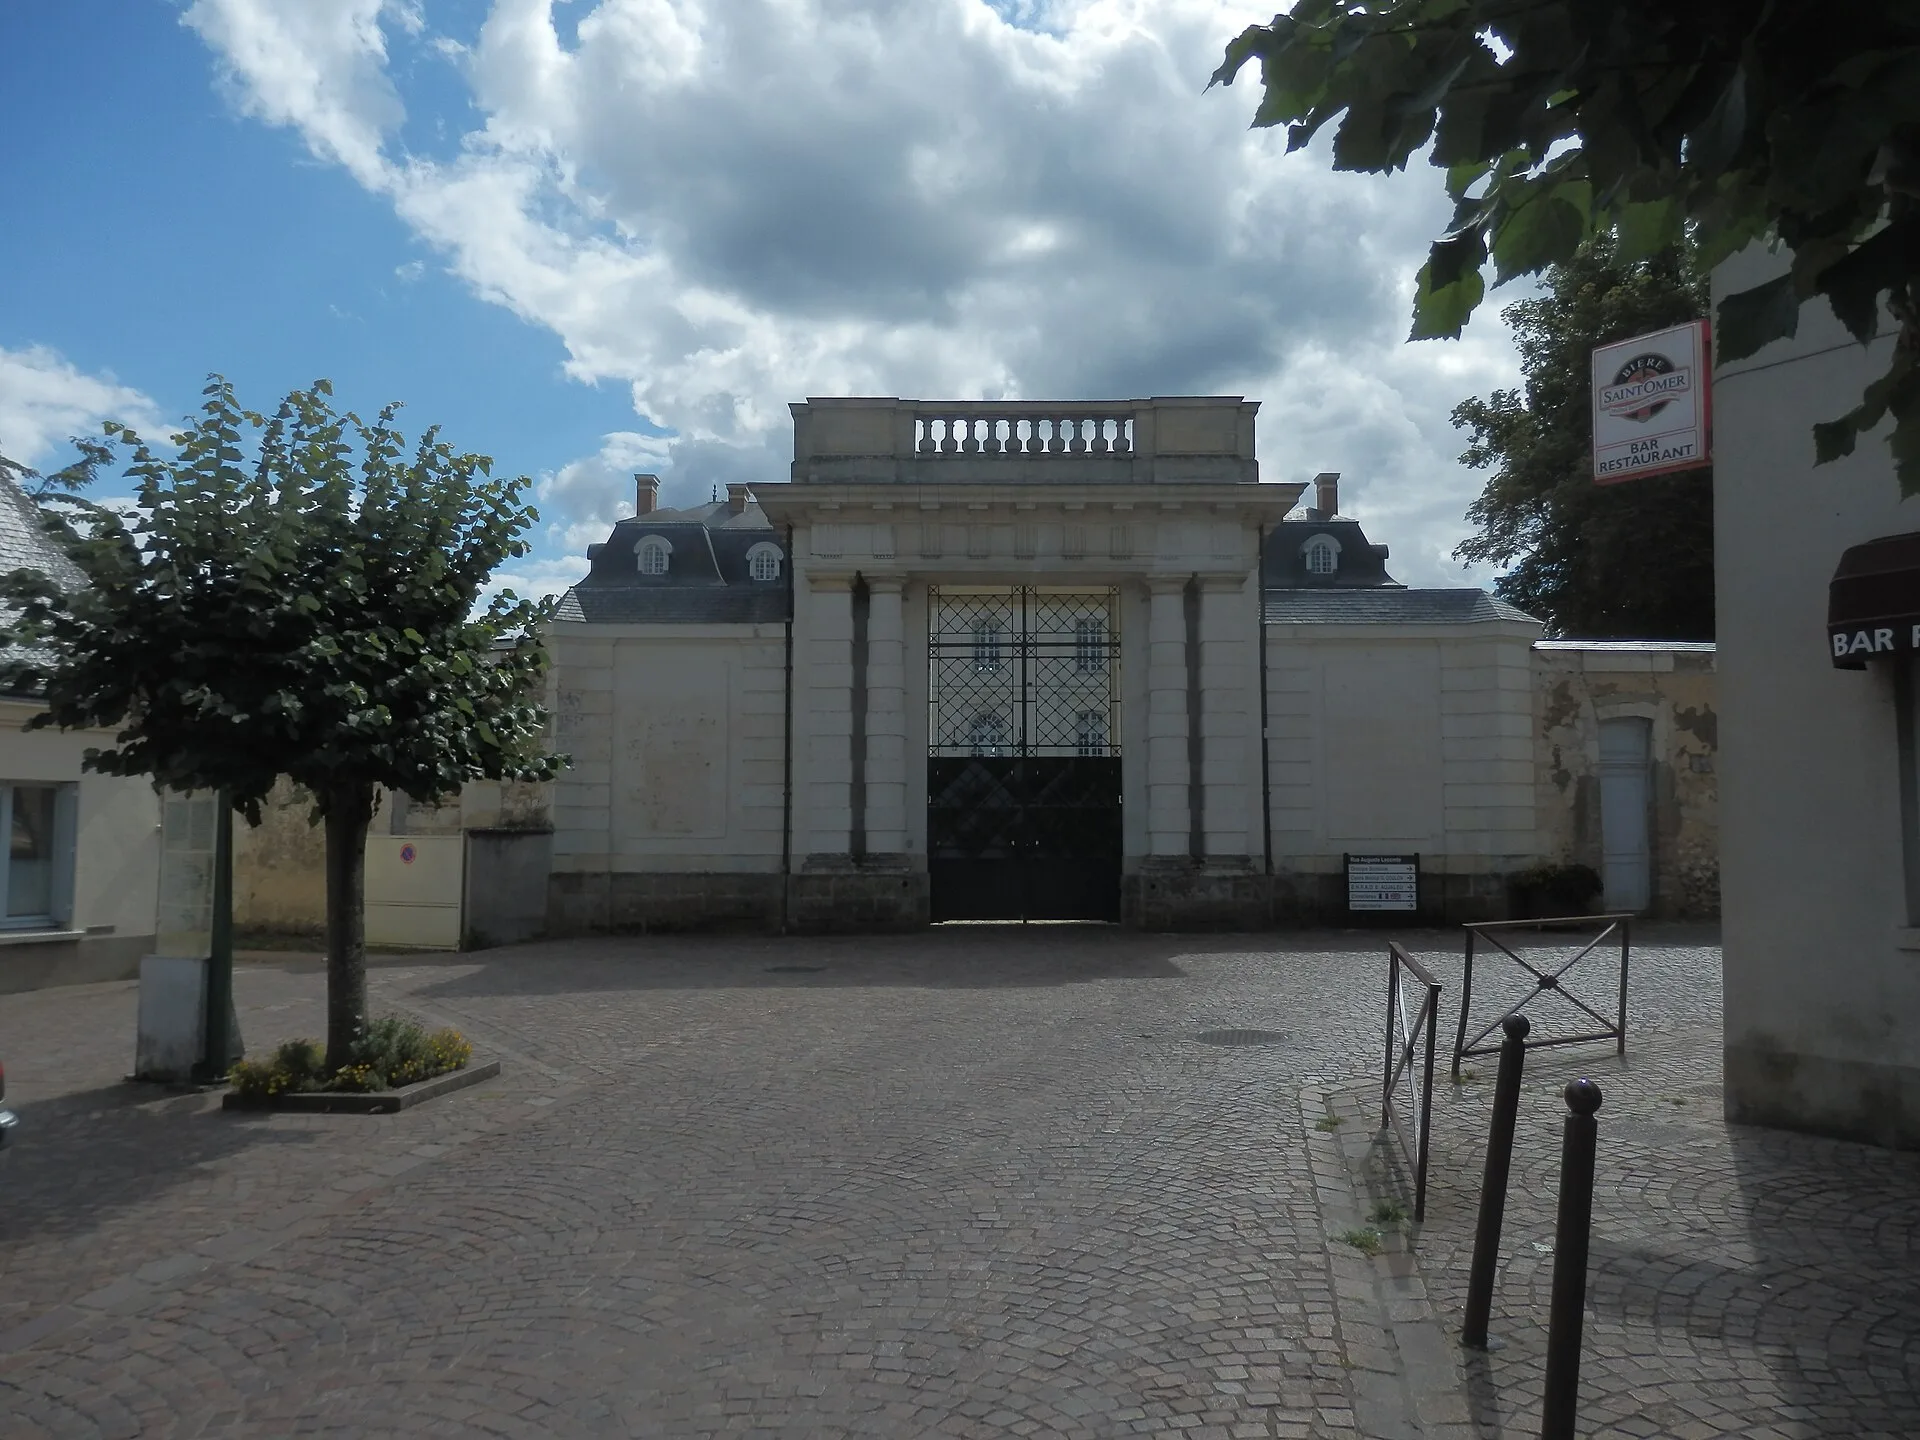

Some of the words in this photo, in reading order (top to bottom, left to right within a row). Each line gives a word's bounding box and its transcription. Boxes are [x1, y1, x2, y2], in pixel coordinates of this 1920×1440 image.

[1599, 444, 1693, 473] RESTAURANT
[1630, 439, 1659, 454] BAR
[1833, 628, 1895, 657] BAR
